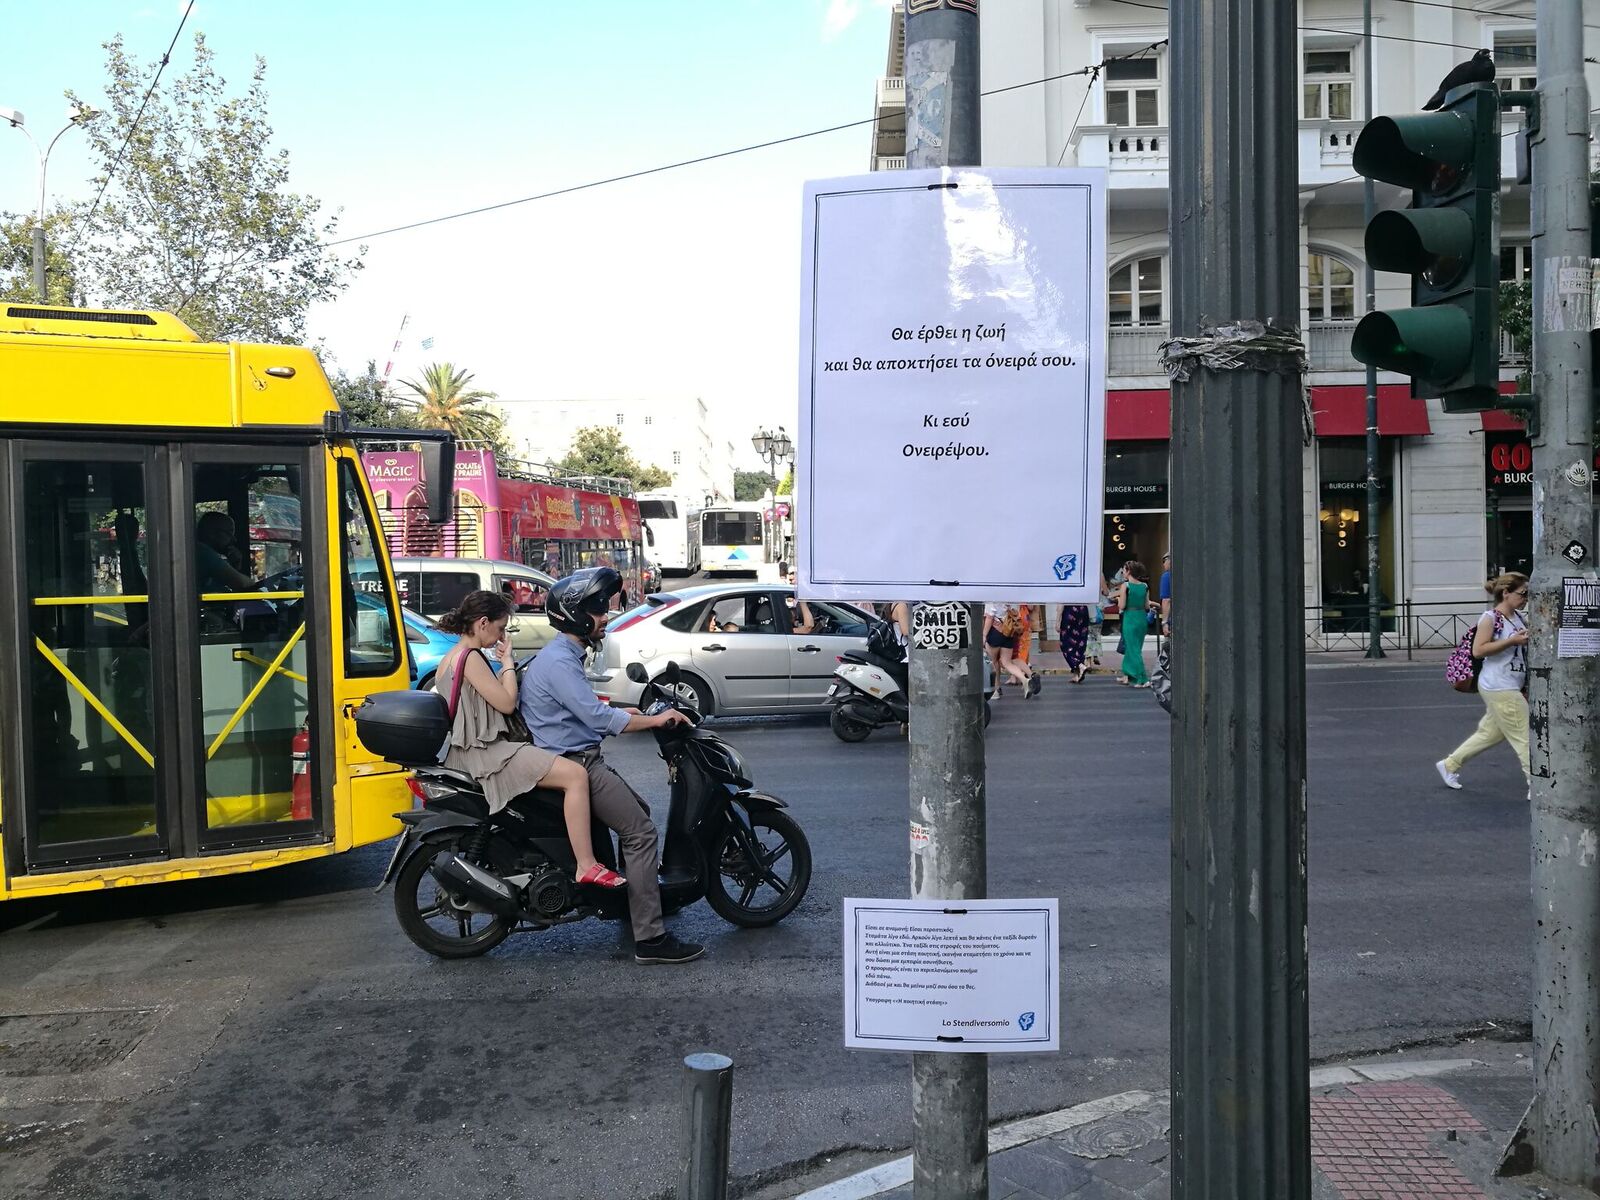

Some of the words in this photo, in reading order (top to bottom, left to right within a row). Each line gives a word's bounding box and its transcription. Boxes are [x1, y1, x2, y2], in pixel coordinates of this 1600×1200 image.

[891, 327, 913, 341] Θα
[917, 324, 958, 343] έρθει
[961, 328, 971, 343] η
[975, 323, 1006, 342] ζωή
[824, 359, 848, 372] και
[852, 357, 872, 371] θα
[876, 356, 958, 373] αποκτήσει
[962, 358, 982, 369] τα
[985, 353, 1038, 371] όνειρά
[1041, 355, 1077, 367] σου.
[923, 414, 938, 428] Κι
[942, 412, 970, 427] εσύ
[902, 442, 989, 460] Ονειρέψου.
[370, 464, 412, 476] MAGIC
[1504, 472, 1534, 483] BURG
[915, 610, 966, 626] SMILE
[922, 628, 958, 644] 365
